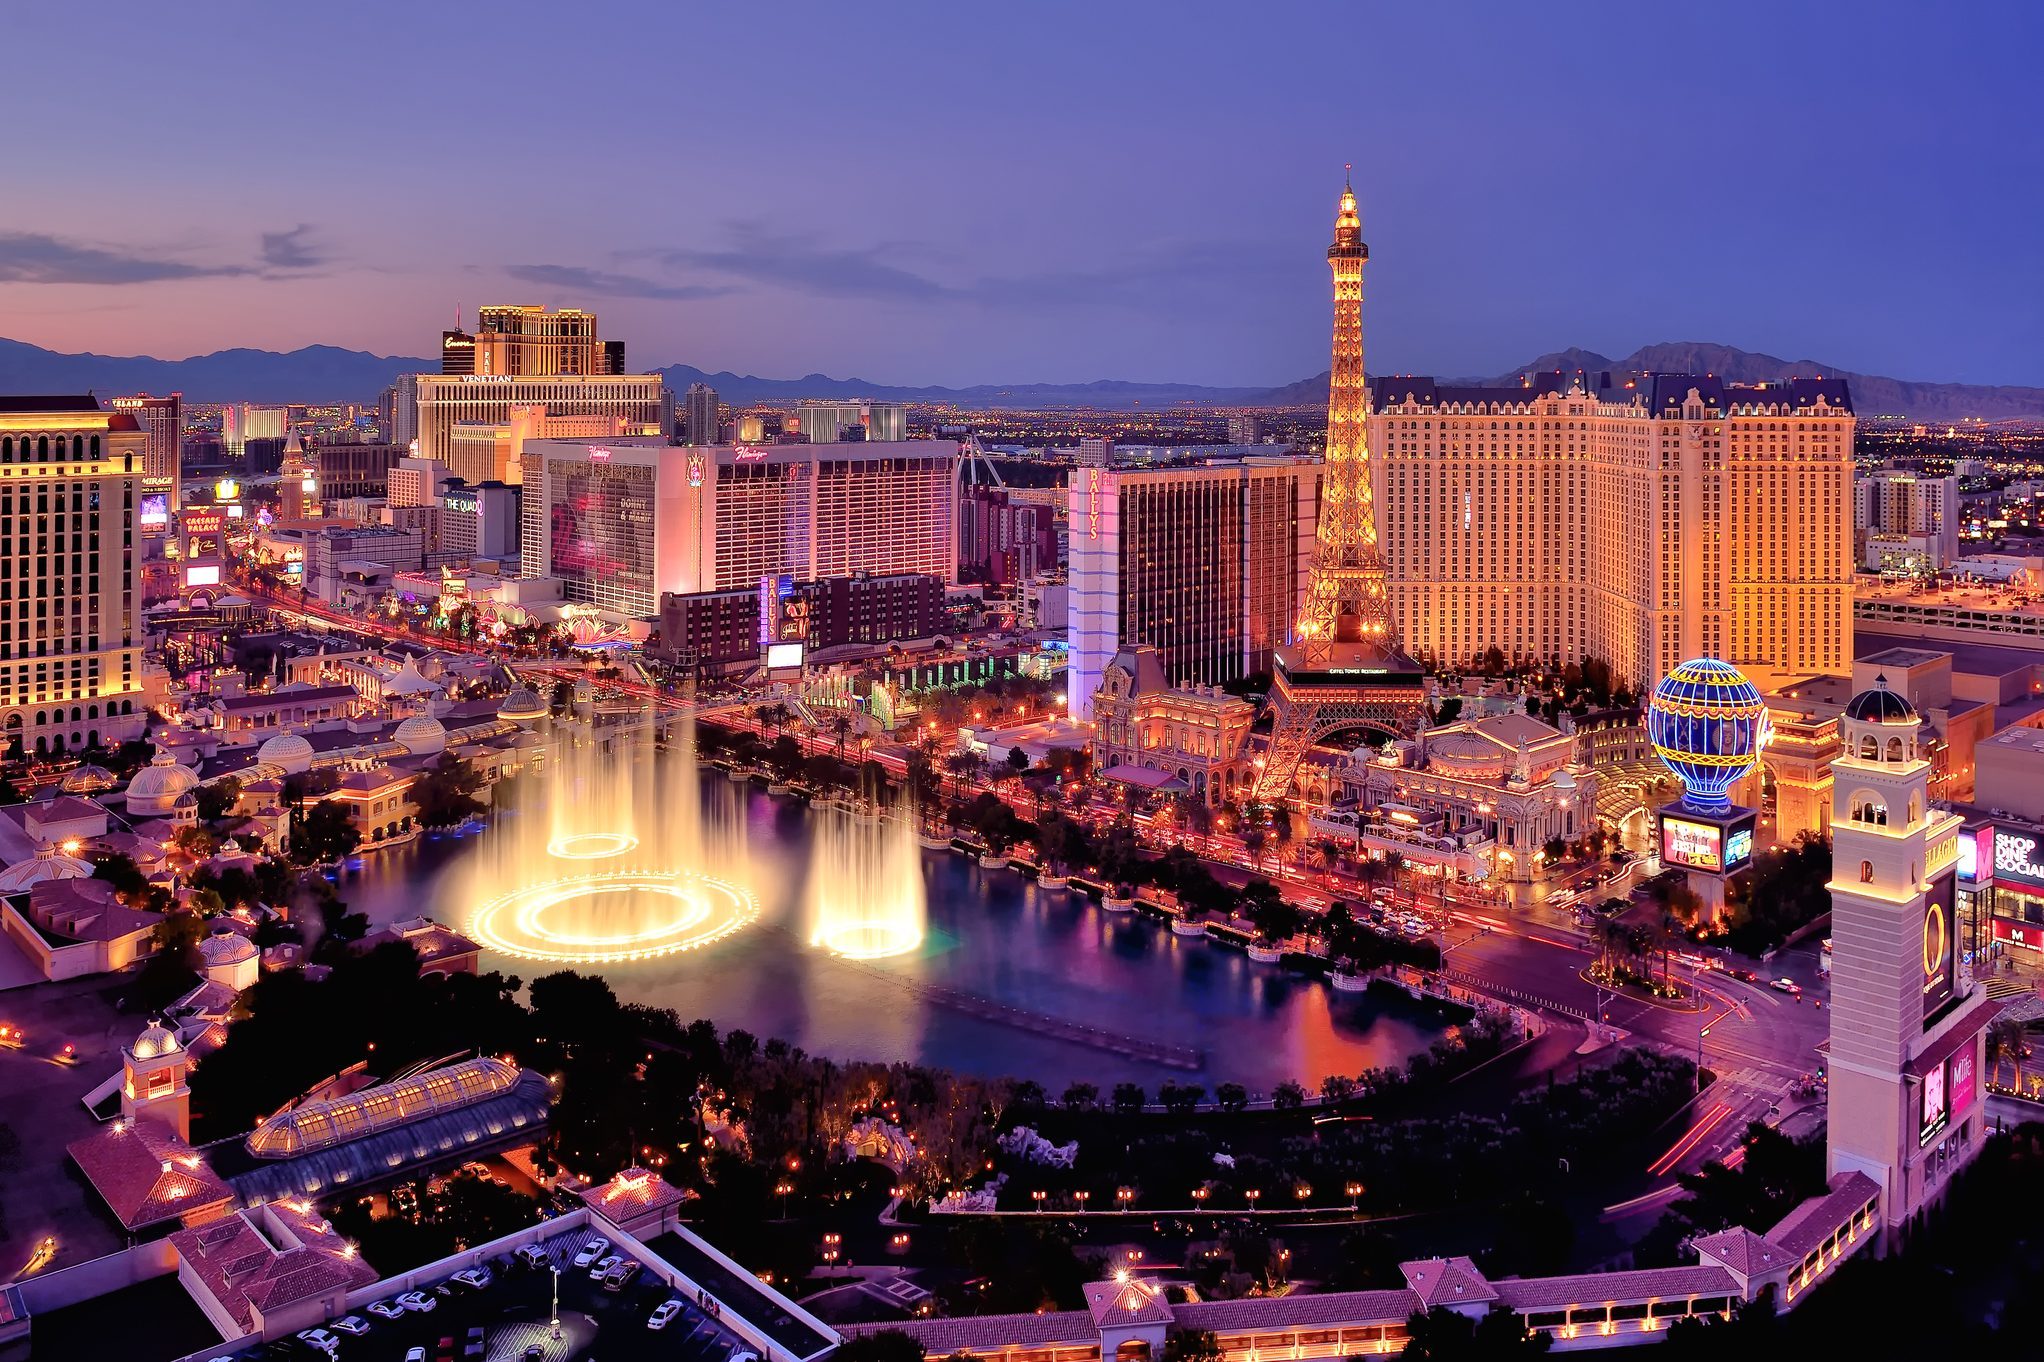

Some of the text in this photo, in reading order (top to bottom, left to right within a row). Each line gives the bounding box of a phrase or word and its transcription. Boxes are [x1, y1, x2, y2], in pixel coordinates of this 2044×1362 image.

[734, 446, 768, 461] Flamingo
[141, 477, 173, 486] MIRAGE
[447, 498, 458, 510] THE
[186, 517, 220, 525] CAESARS
[187, 524, 218, 532] PALACE
[1995, 833, 2036, 852] SHOP
[1995, 846, 2028, 863] DINE
[1923, 903, 1945, 977] O
[2011, 928, 2024, 941] M
